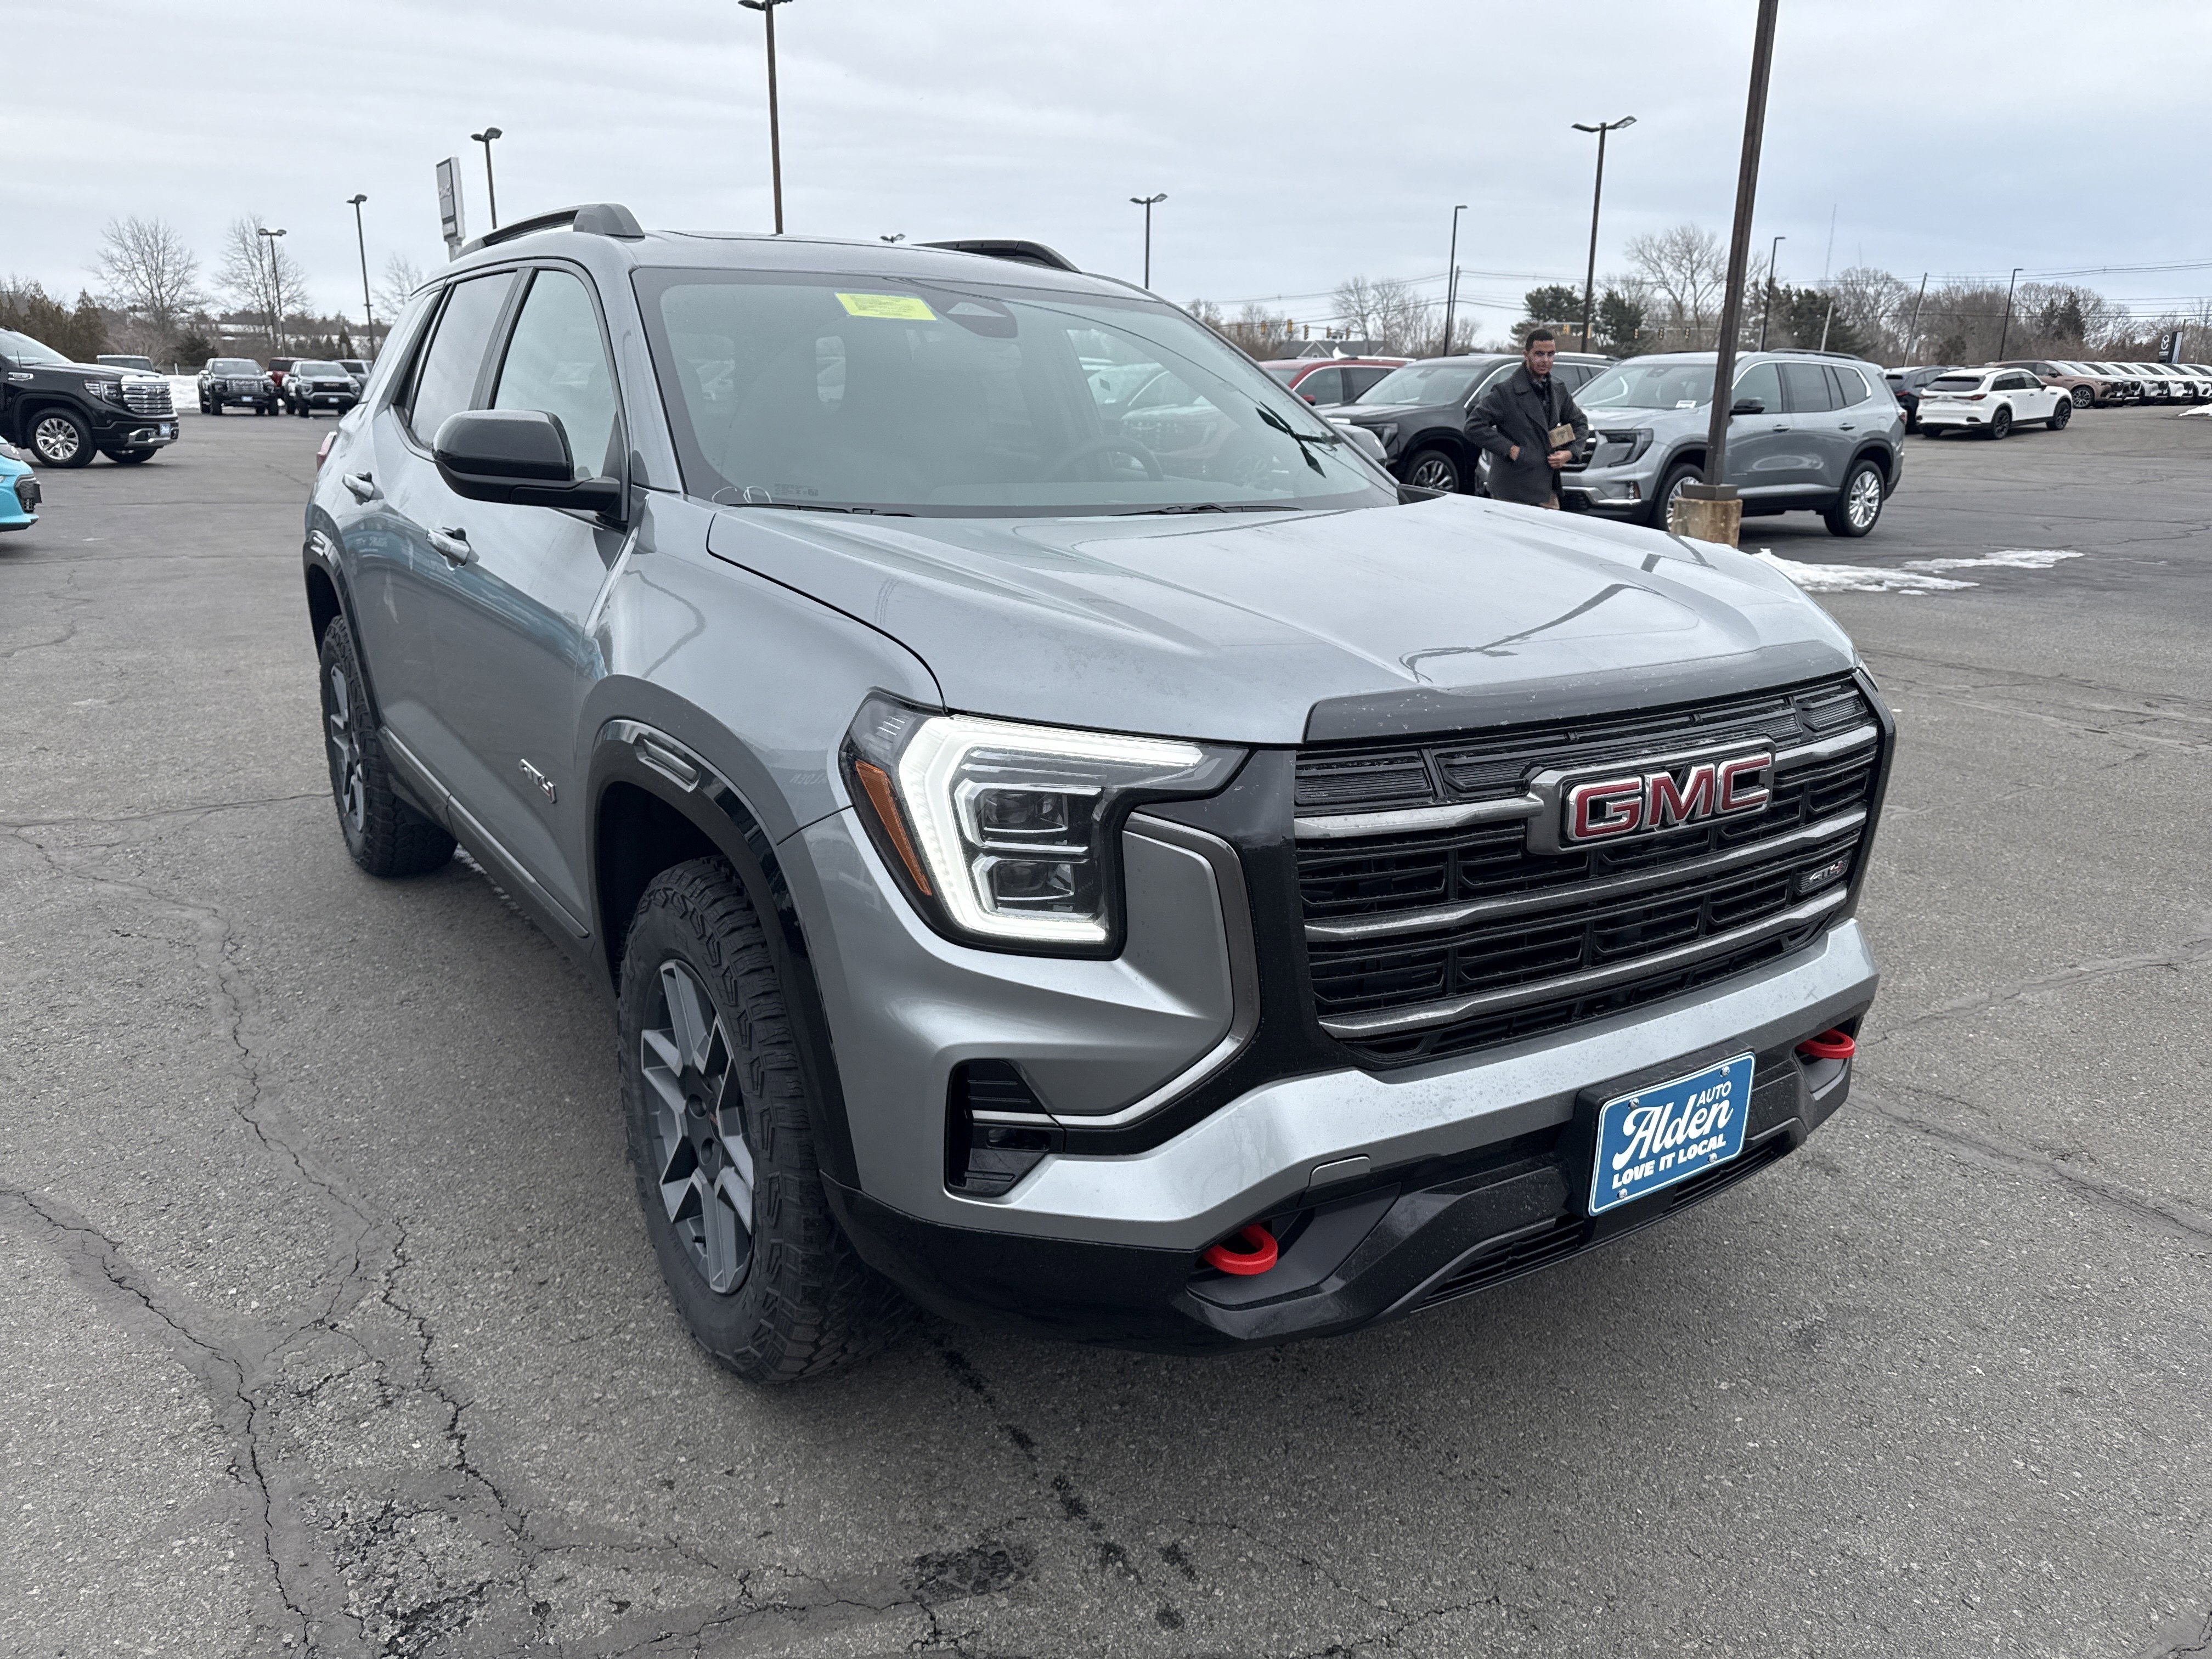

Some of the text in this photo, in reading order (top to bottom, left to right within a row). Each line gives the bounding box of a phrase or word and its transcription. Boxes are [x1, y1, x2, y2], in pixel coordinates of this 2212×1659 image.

[1567, 752, 1772, 842] GMC
[1696, 1081, 1731, 1107] AUTO
[1612, 1093, 1734, 1171] Alden
[1612, 1133, 1726, 1189] LOVE IT LOCAL
